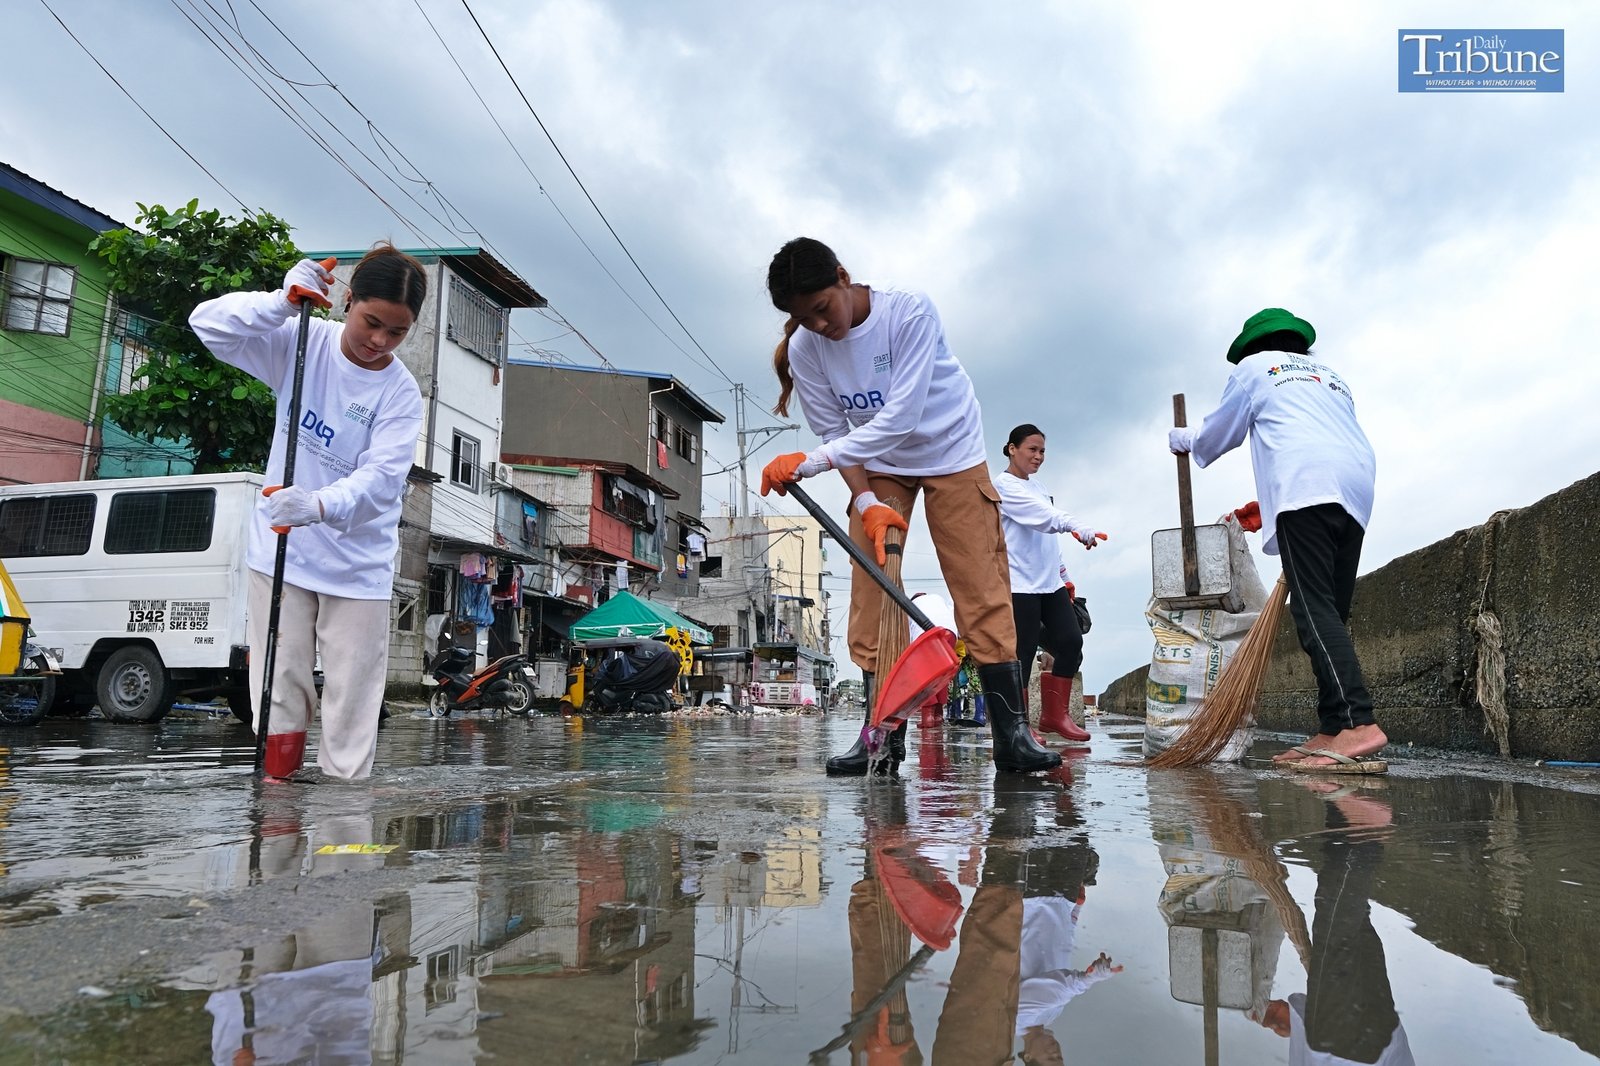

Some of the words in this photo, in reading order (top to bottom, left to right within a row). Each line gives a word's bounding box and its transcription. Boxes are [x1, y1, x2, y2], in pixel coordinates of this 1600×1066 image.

[873, 353, 890, 365] START
[349, 402, 369, 416] START
[344, 411, 360, 423] START
[129, 611, 164, 622] 1342
[170, 621, 188, 630] SKE
[190, 621, 208, 630] 952
[194, 636, 203, 645] FOR
[203, 636, 214, 645] HIRE
